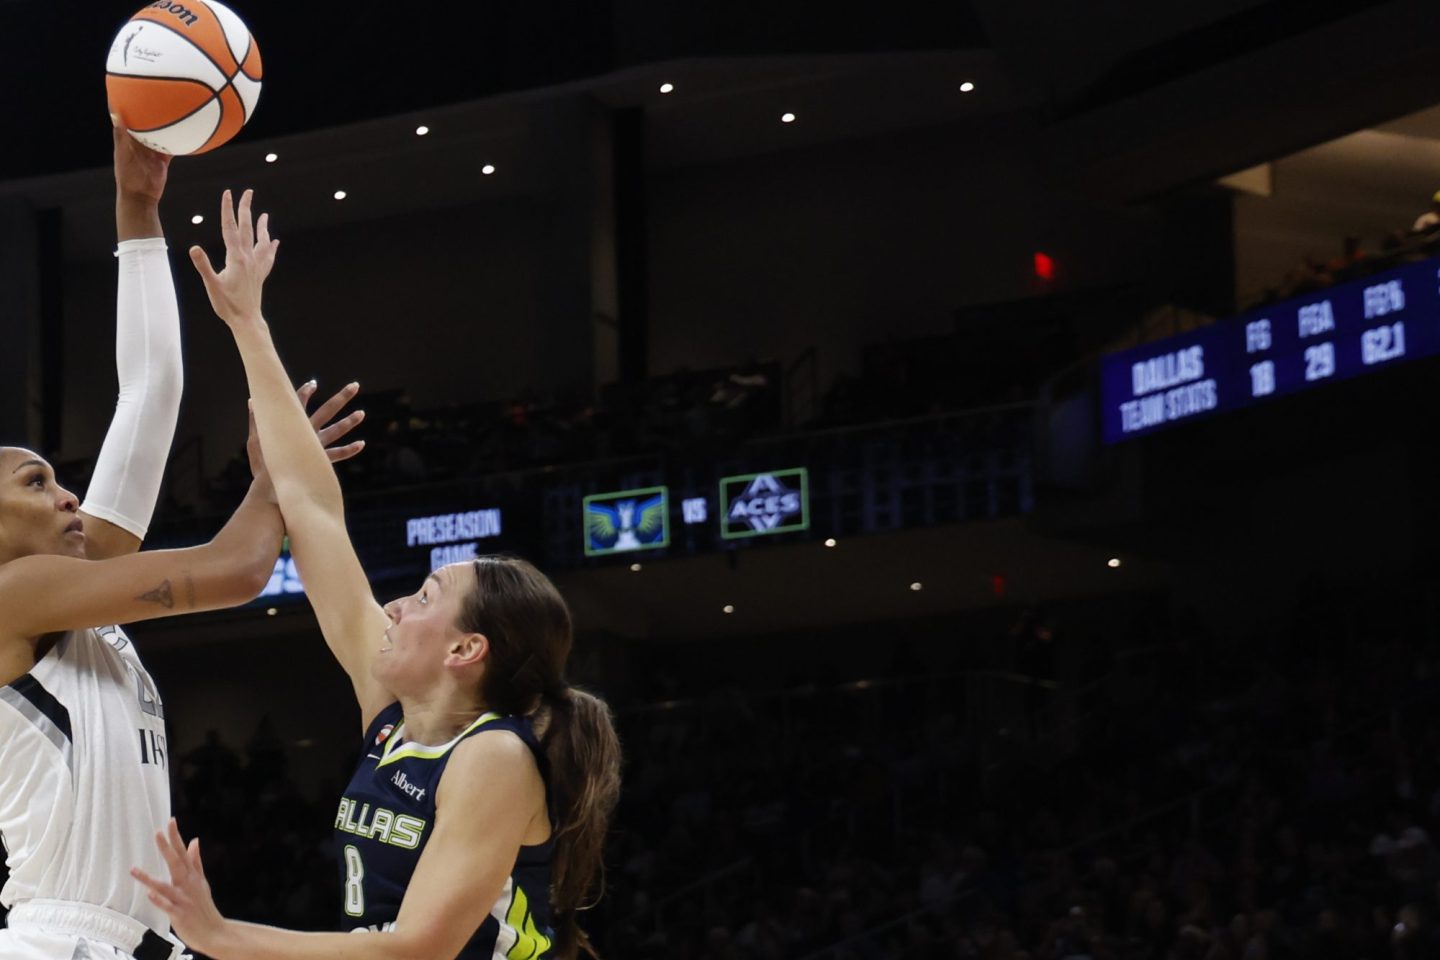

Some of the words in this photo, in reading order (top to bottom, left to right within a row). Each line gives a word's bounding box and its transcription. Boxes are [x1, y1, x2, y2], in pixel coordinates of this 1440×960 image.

[1246, 318, 1272, 353] FG
[1298, 300, 1335, 338] FGA
[1132, 344, 1205, 396] DALLAS
[1119, 395, 1165, 433] TEAM
[1163, 378, 1218, 420] STATS
[407, 508, 501, 547] PRESEASON
[730, 493, 800, 519] ACES
[390, 769, 426, 801] Albert
[334, 797, 426, 849] ALLAS
[344, 844, 364, 917] 8
